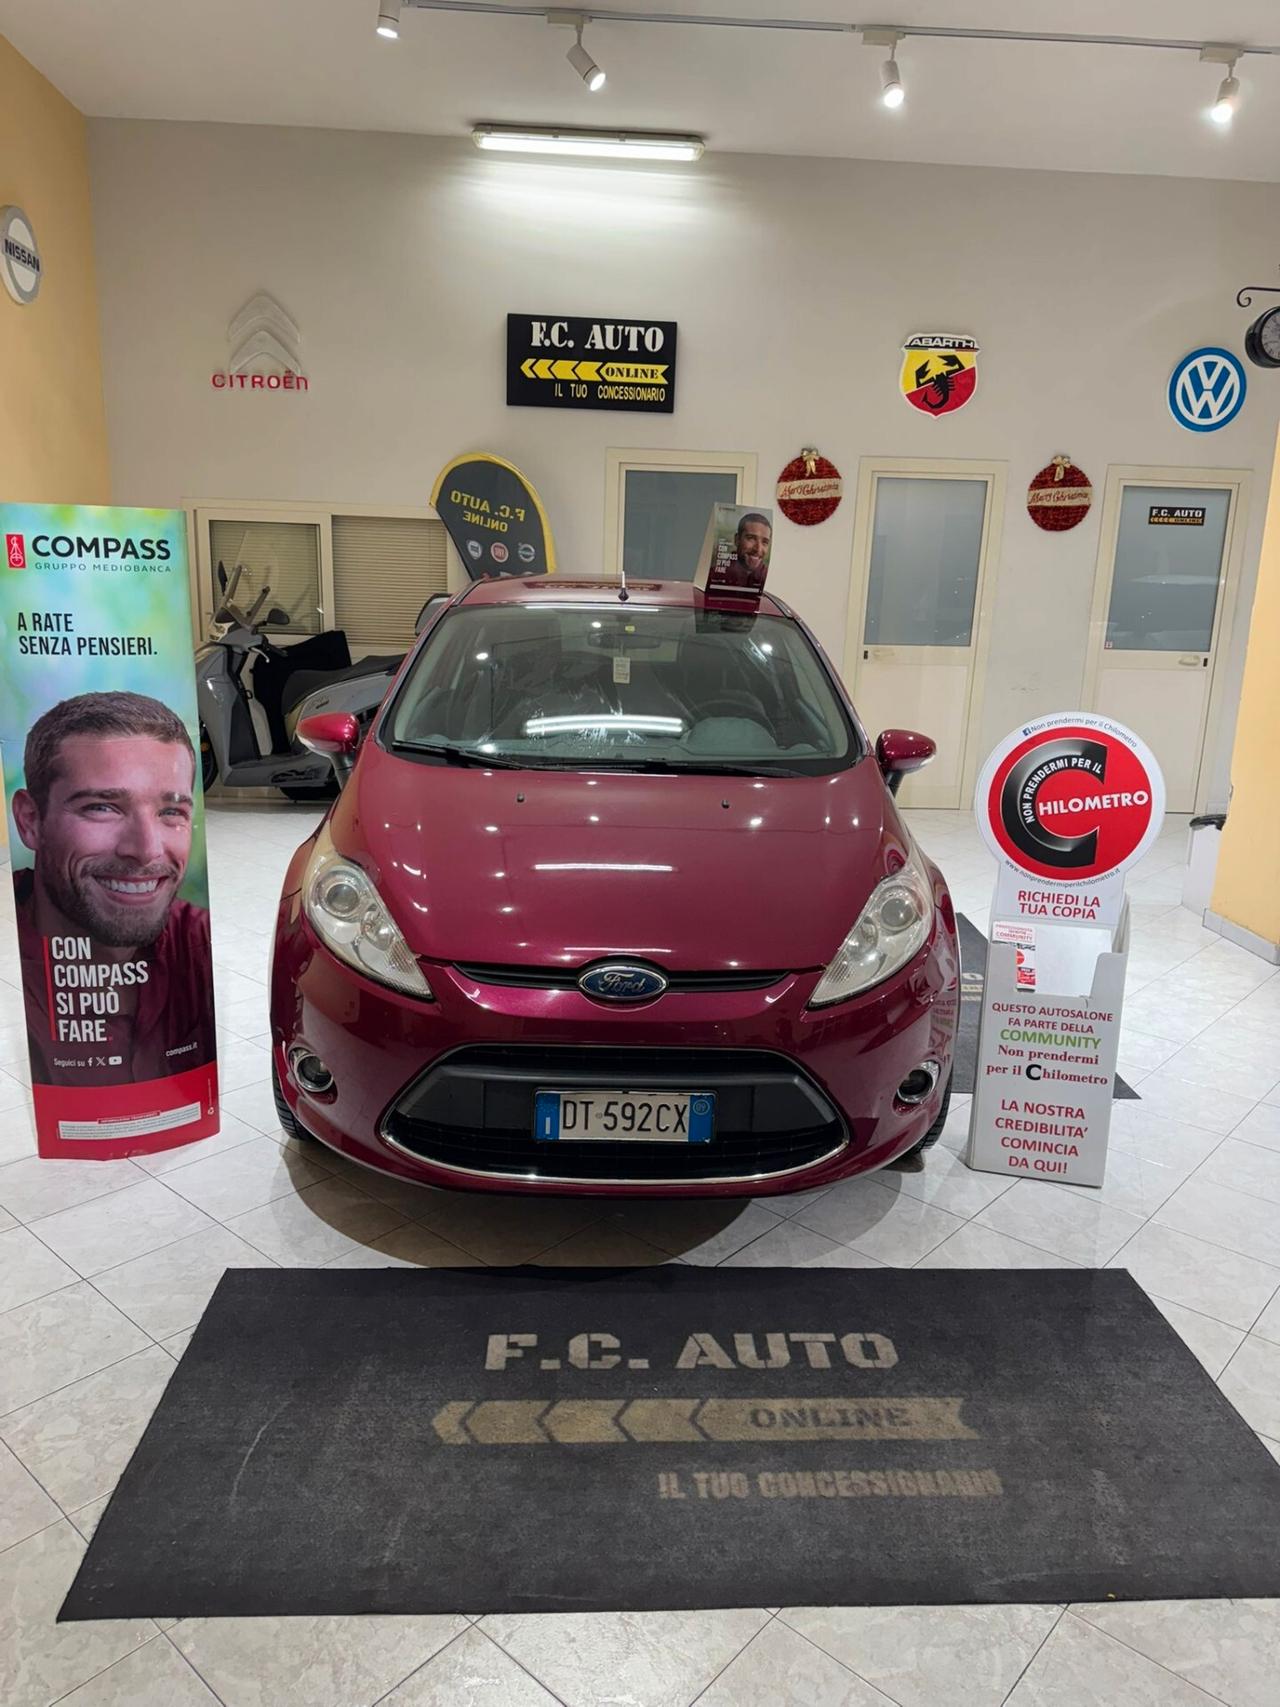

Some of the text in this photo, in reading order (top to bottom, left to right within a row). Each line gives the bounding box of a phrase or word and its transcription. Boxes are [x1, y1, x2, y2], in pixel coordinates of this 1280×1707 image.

[5, 238, 40, 272] NISSAN
[531, 321, 665, 353] F.C. AUTO
[911, 337, 974, 348] ABARTH
[605, 366, 660, 380] ONLINE
[554, 383, 666, 402] IL TUO CONCESSIONARIO
[1152, 508, 1203, 518] F.C. AUTO
[32, 535, 171, 561] COMPASS
[35, 562, 172, 573] GRUPPO MEDIOBANCA
[17, 612, 74, 632] A RATE
[19, 636, 158, 656] SENZA PENSIERI.
[1031, 722, 1047, 732] Non
[1046, 717, 1084, 728] prendermi
[1085, 718, 1097, 726] per
[1103, 723, 1138, 748] Chilometro
[1022, 757, 1103, 824] NON PRENDERMI PER IL
[1018, 890, 1100, 908] RICHIEDI LA
[1020, 902, 1096, 919] TUA COPIA
[51, 936, 91, 960] CON
[54, 961, 149, 988] COMPASS
[598, 971, 646, 993] Ford
[56, 986, 120, 1015] SI PUÒ
[992, 1002, 1113, 1022] QUESTO AUTOSALONE
[1008, 1017, 1094, 1034] FA PARTE DELLA
[1000, 1029, 1101, 1049] COMMUNITY
[165, 1042, 198, 1057] compass.it
[998, 1044, 1099, 1065] Non prendermi
[53, 1058, 86, 1068] Seguici su
[986, 1063, 1108, 1086] per il Chilometro
[562, 1100, 595, 1130] DT
[603, 1101, 688, 1133] 592CX
[1001, 1099, 1085, 1119] LA NOSTRA
[1001, 1136, 1079, 1157] COMINCIA
[1008, 1155, 1068, 1174] DA QUI!
[484, 1333, 899, 1370] F.C. AUTO
[749, 1406, 911, 1430] ONLINE
[658, 1472, 686, 1499] IL
[693, 1472, 748, 1499] TUO
